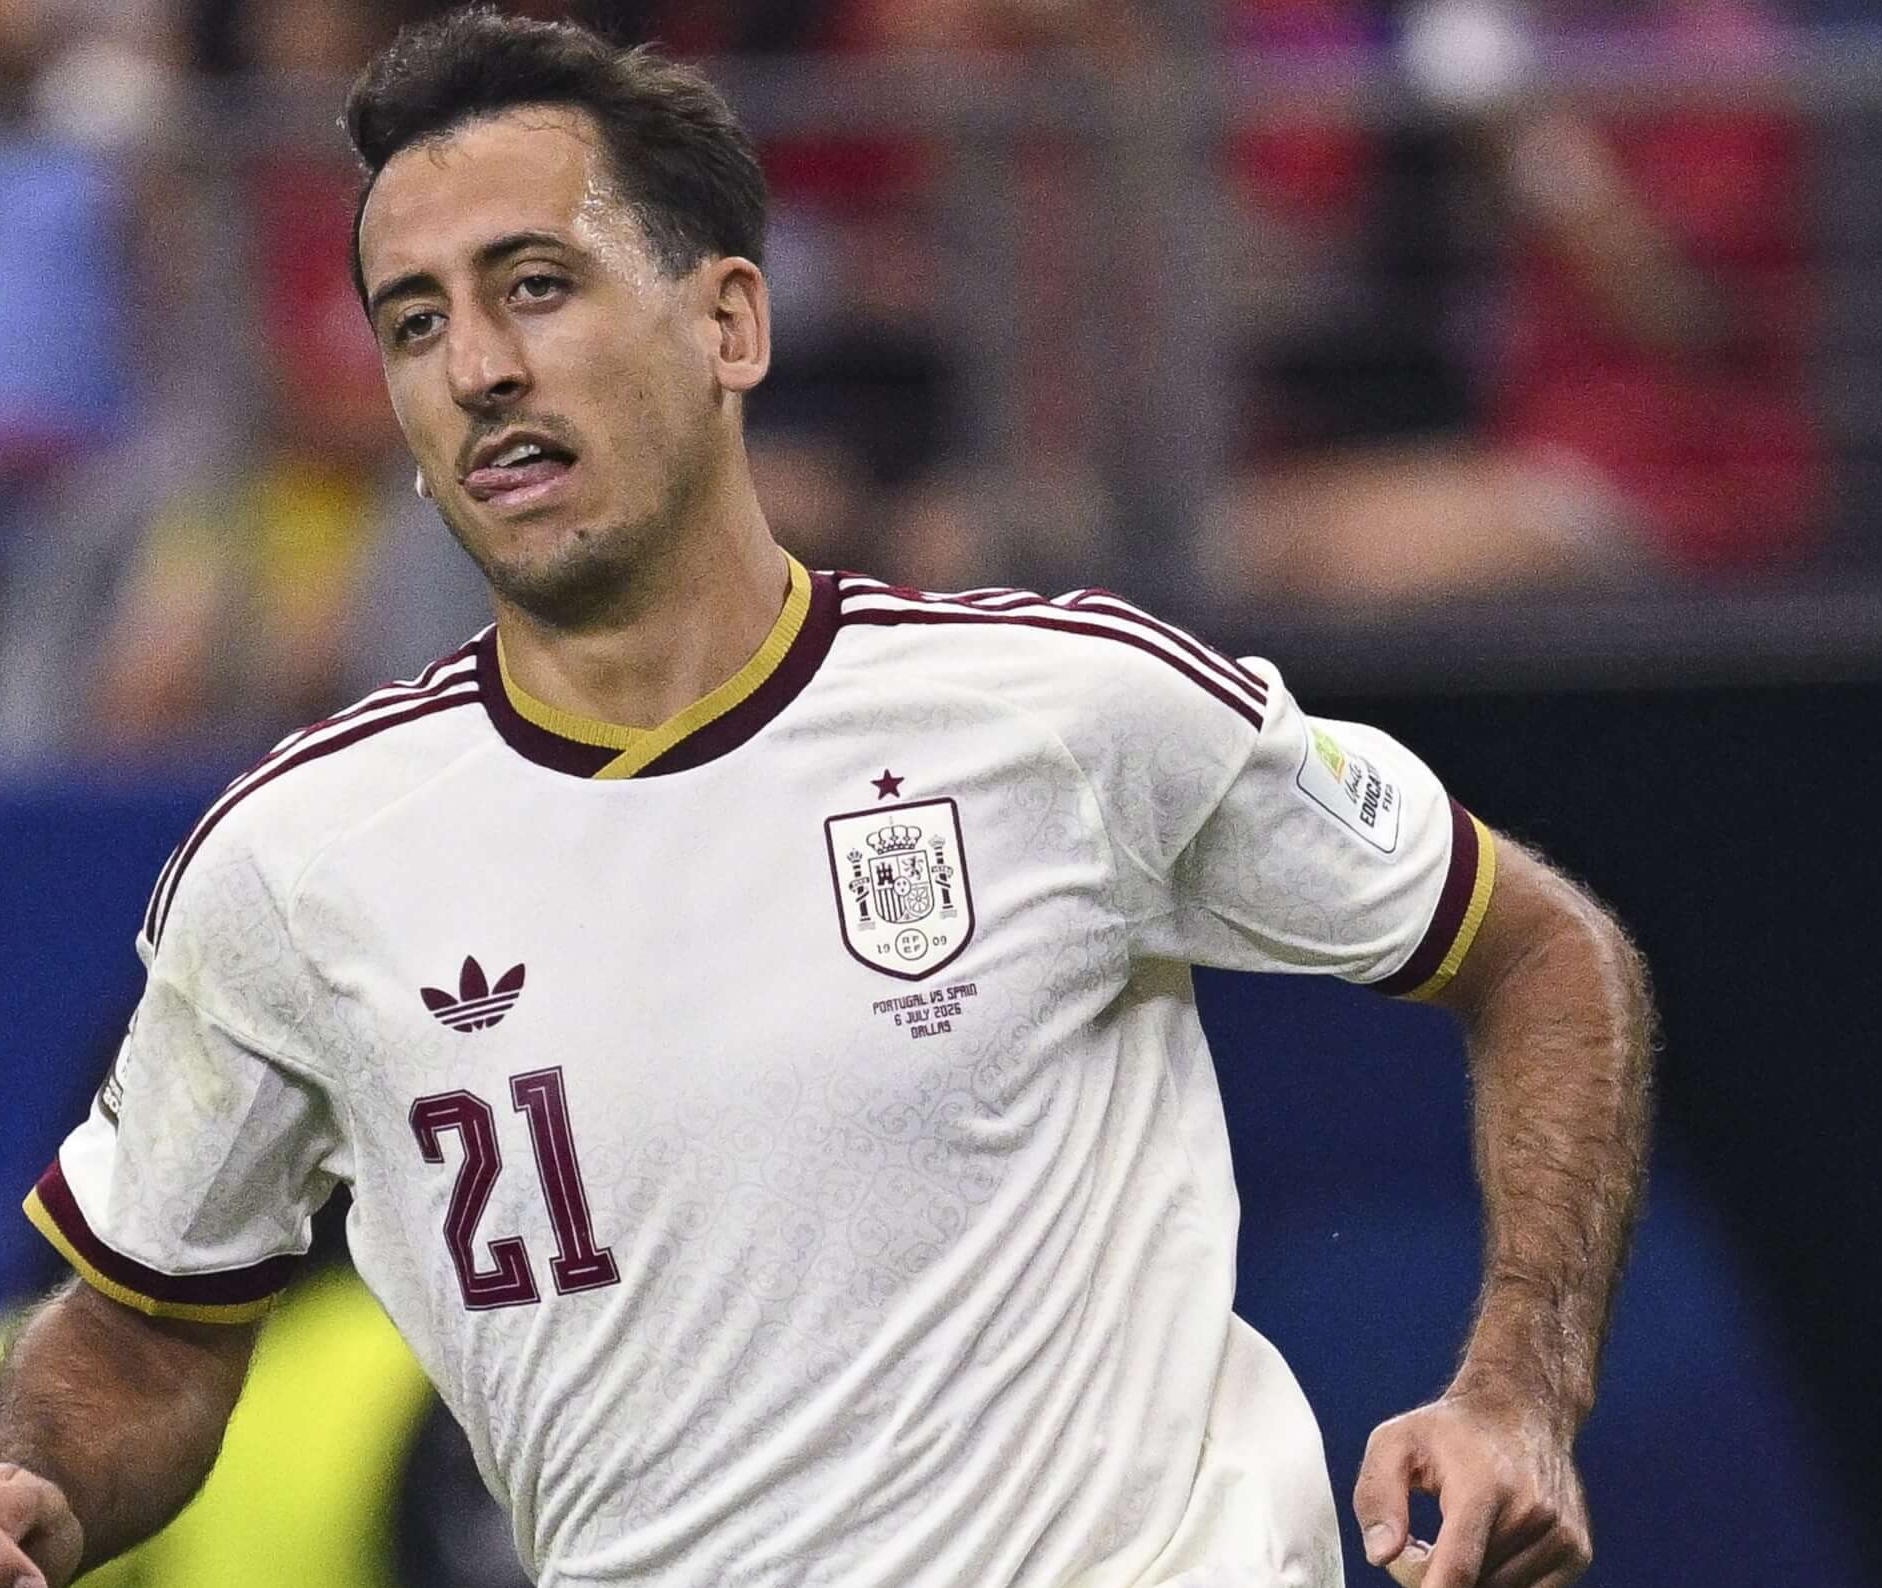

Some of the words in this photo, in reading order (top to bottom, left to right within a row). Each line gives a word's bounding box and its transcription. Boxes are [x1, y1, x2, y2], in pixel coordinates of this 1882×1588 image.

[872, 994, 926, 1014] PORTUGAL
[929, 989, 943, 1002] VS
[946, 983, 977, 999] SPAIN
[894, 1013, 902, 1025] 6
[905, 1008, 929, 1023] JULY
[934, 1002, 961, 1017] 2026
[910, 1020, 951, 1038] DALLAS
[408, 1065, 621, 1311] 21
